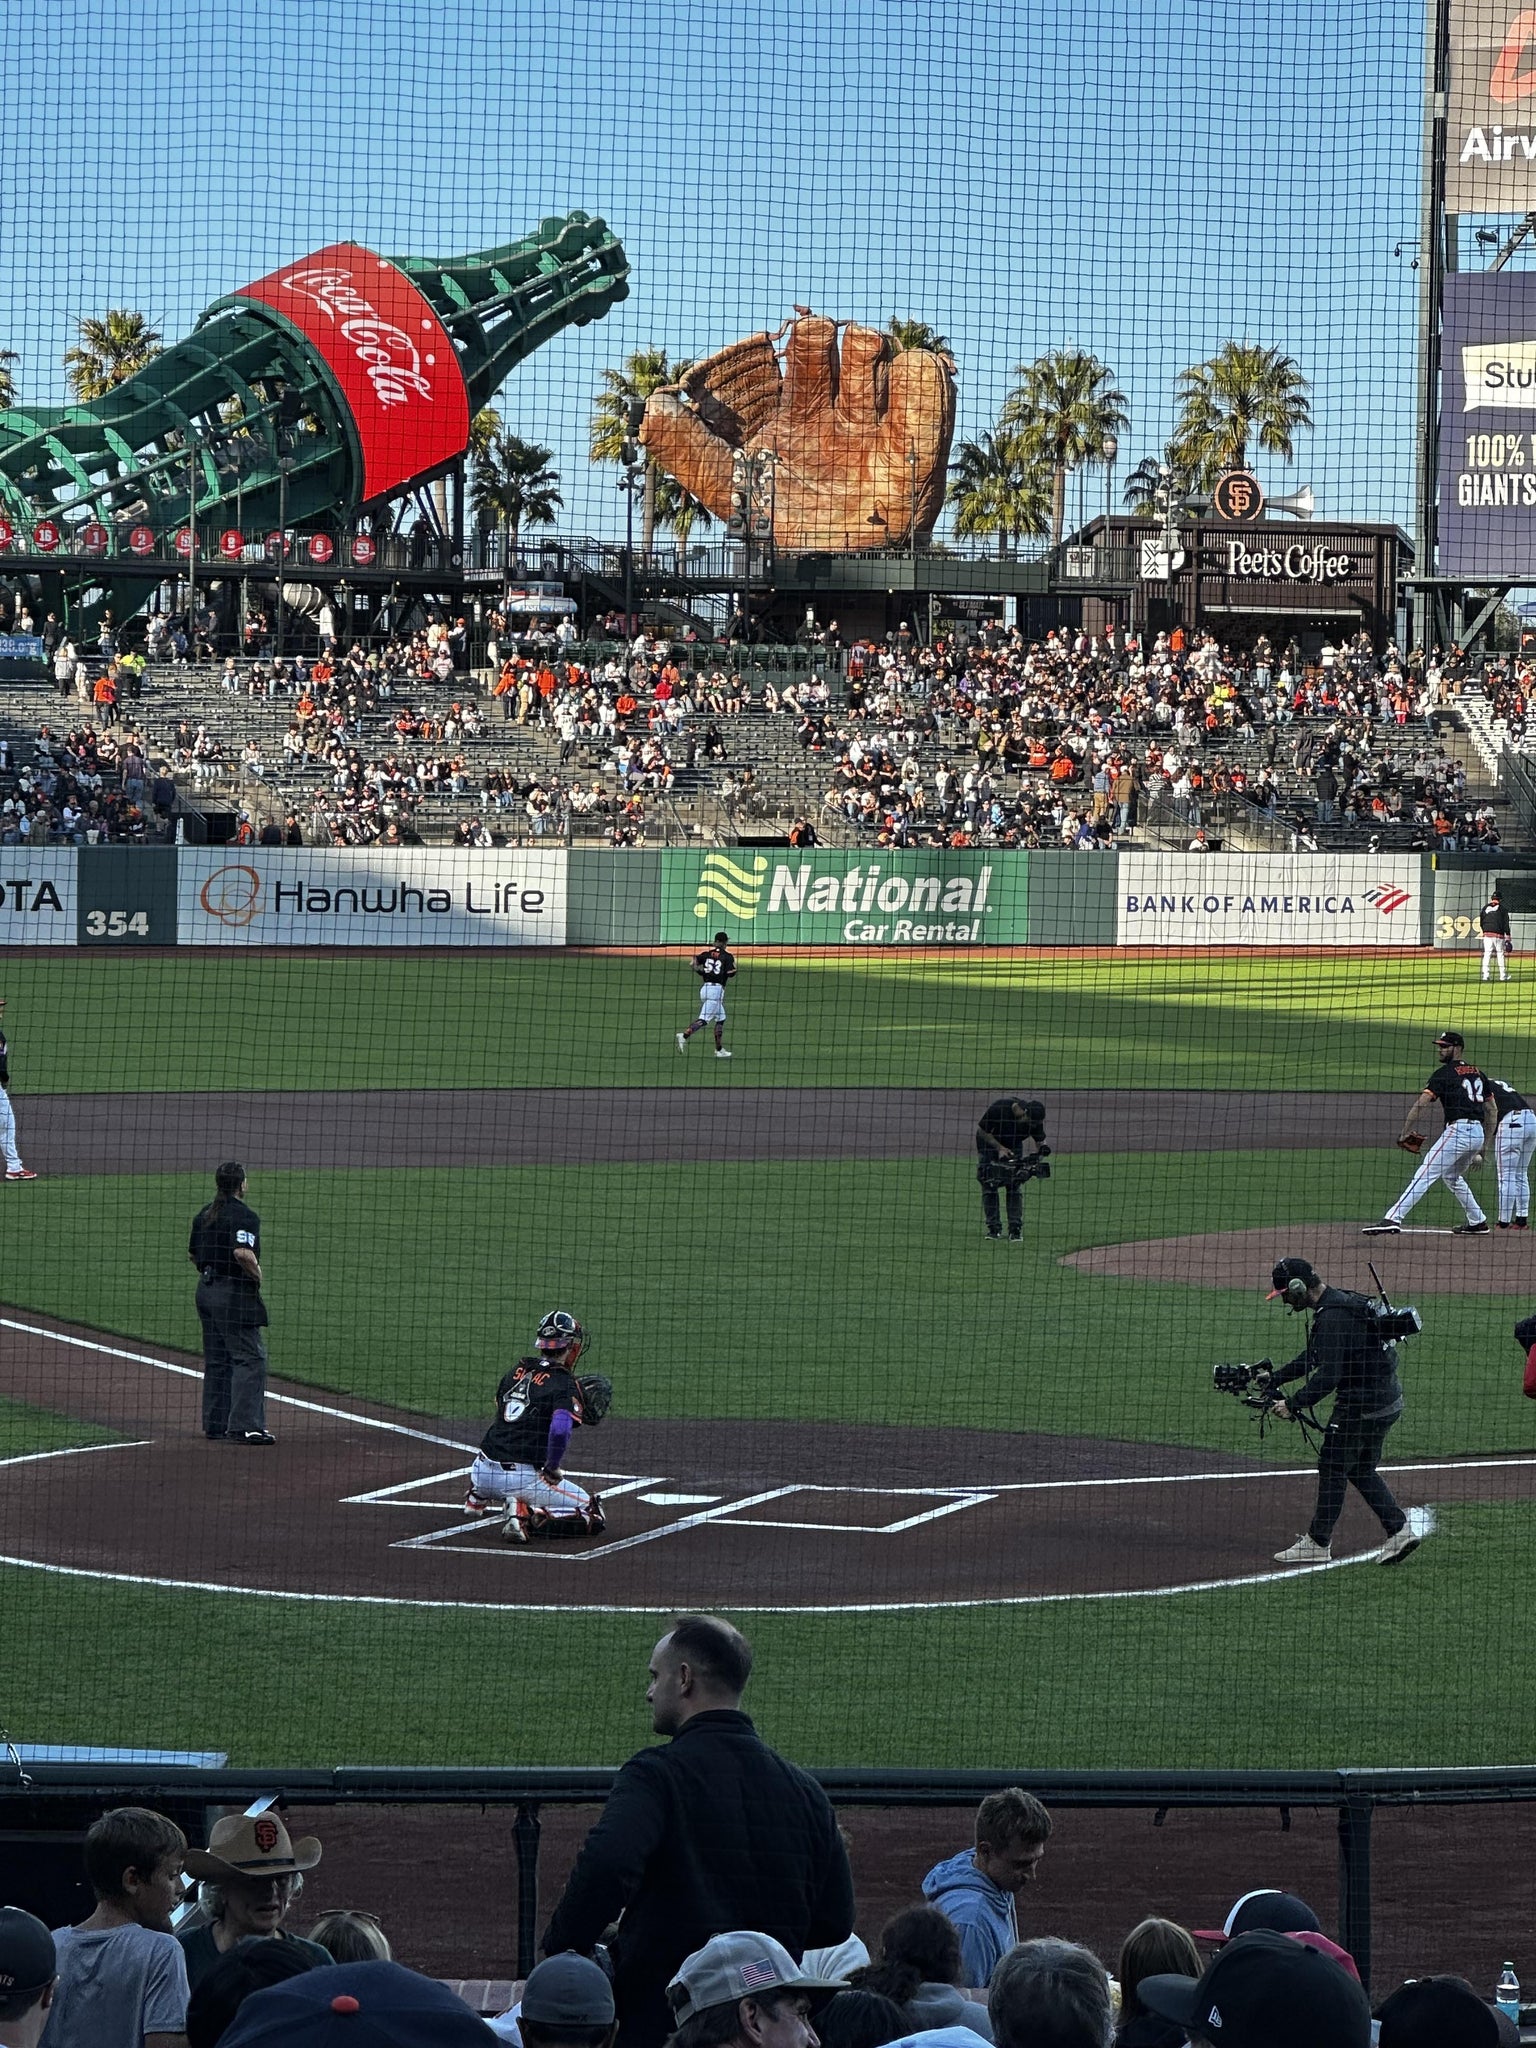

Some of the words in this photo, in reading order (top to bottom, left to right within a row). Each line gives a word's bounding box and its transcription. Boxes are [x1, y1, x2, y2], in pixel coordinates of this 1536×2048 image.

[281, 268, 434, 407] Coca-Cola
[1485, 362, 1536, 388] Stu
[1466, 434, 1524, 467] 100%
[1458, 473, 1536, 506] GIANTS
[1227, 541, 1282, 577] Peet's
[1284, 544, 1349, 582] Coffee
[0, 881, 63, 911] TA
[275, 881, 450, 913] Hanwha
[466, 882, 544, 913] Life
[1126, 895, 1195, 913] BANK
[1203, 895, 1235, 913] OF
[1241, 896, 1355, 914] AMERICA
[86, 910, 149, 936] 354
[844, 920, 889, 941] Car
[893, 919, 980, 941] Rental
[703, 958, 722, 975] 53
[1462, 1076, 1484, 1102] 12
